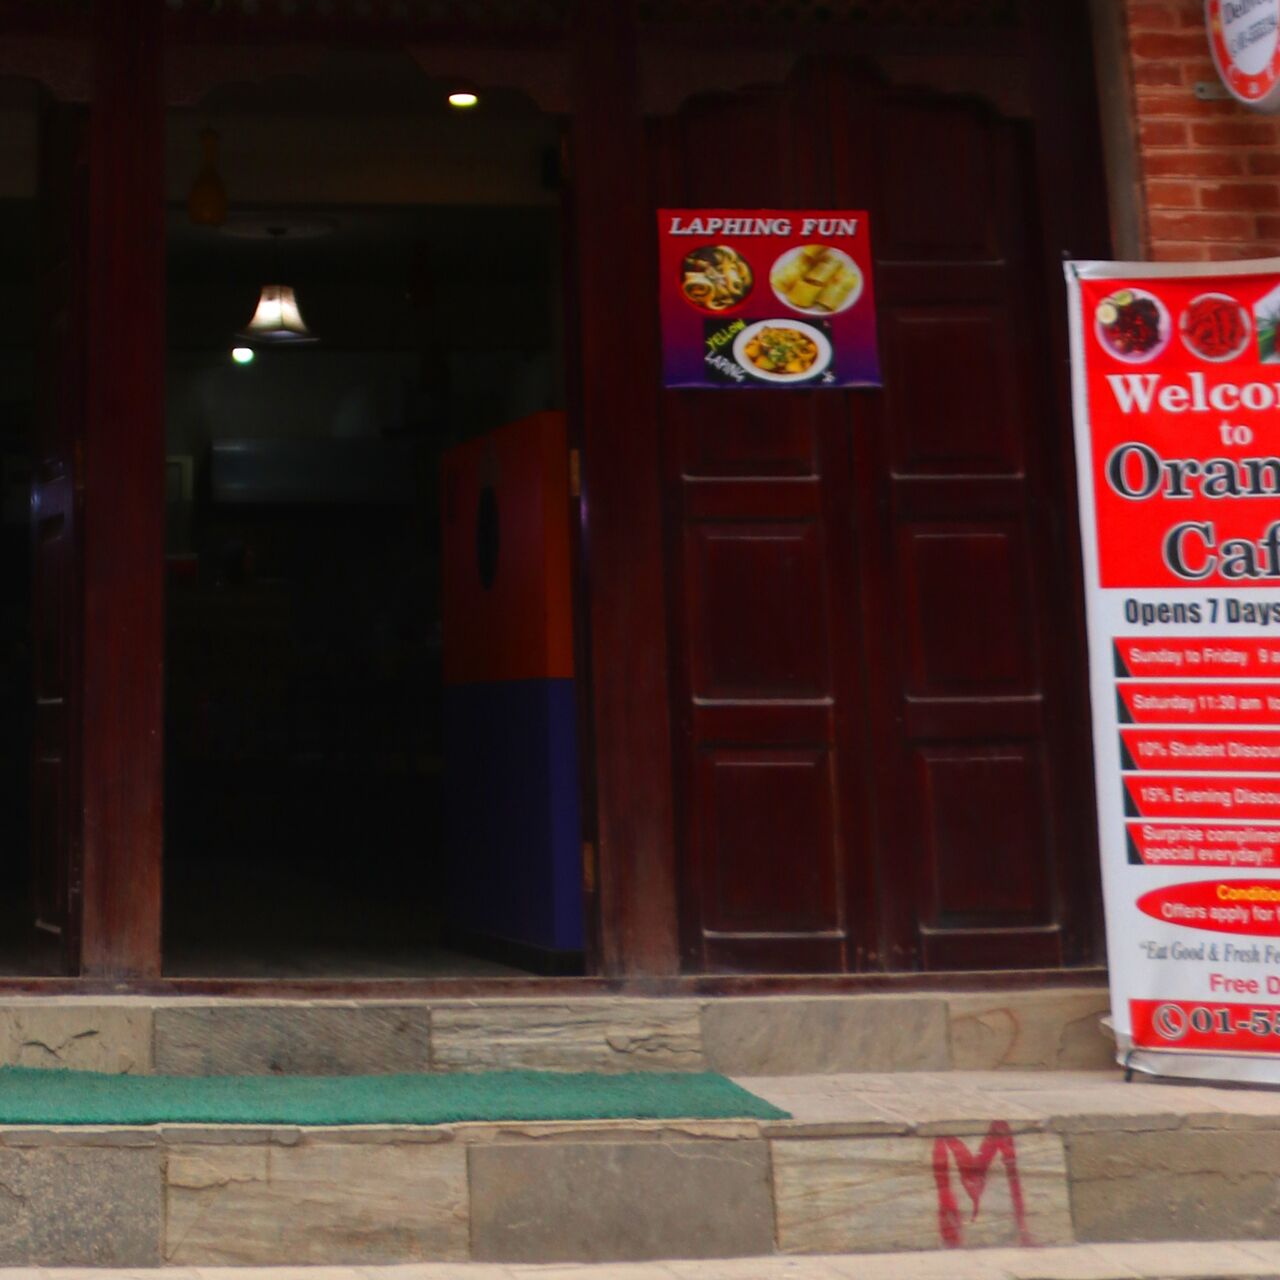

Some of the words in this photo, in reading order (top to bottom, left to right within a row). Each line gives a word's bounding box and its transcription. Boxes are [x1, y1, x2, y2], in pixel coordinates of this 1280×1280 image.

[669, 217, 792, 236] LAPHING
[800, 218, 858, 236] FUN
[1107, 372, 1280, 414] Welco
[1219, 420, 1253, 446] to
[1125, 598, 1202, 627] Opens
[1206, 598, 1219, 624] 7
[1130, 647, 1182, 666] Sunday
[1185, 648, 1200, 663] to
[1203, 648, 1248, 667] Friday
[1133, 694, 1195, 713] Saturday
[1239, 697, 1262, 710] am
[1137, 742, 1167, 757] 10%
[1170, 742, 1225, 757] Student
[1173, 788, 1232, 807] Evening
[1143, 825, 1203, 843] Surprise
[1146, 846, 1195, 864] special
[1161, 903, 1207, 918] Offers
[1209, 904, 1250, 923] apply
[1252, 905, 1274, 921] for
[1171, 942, 1204, 961] Good
[1208, 943, 1219, 962] &
[1224, 943, 1260, 964] Fresh
[1209, 973, 1259, 995] Free
